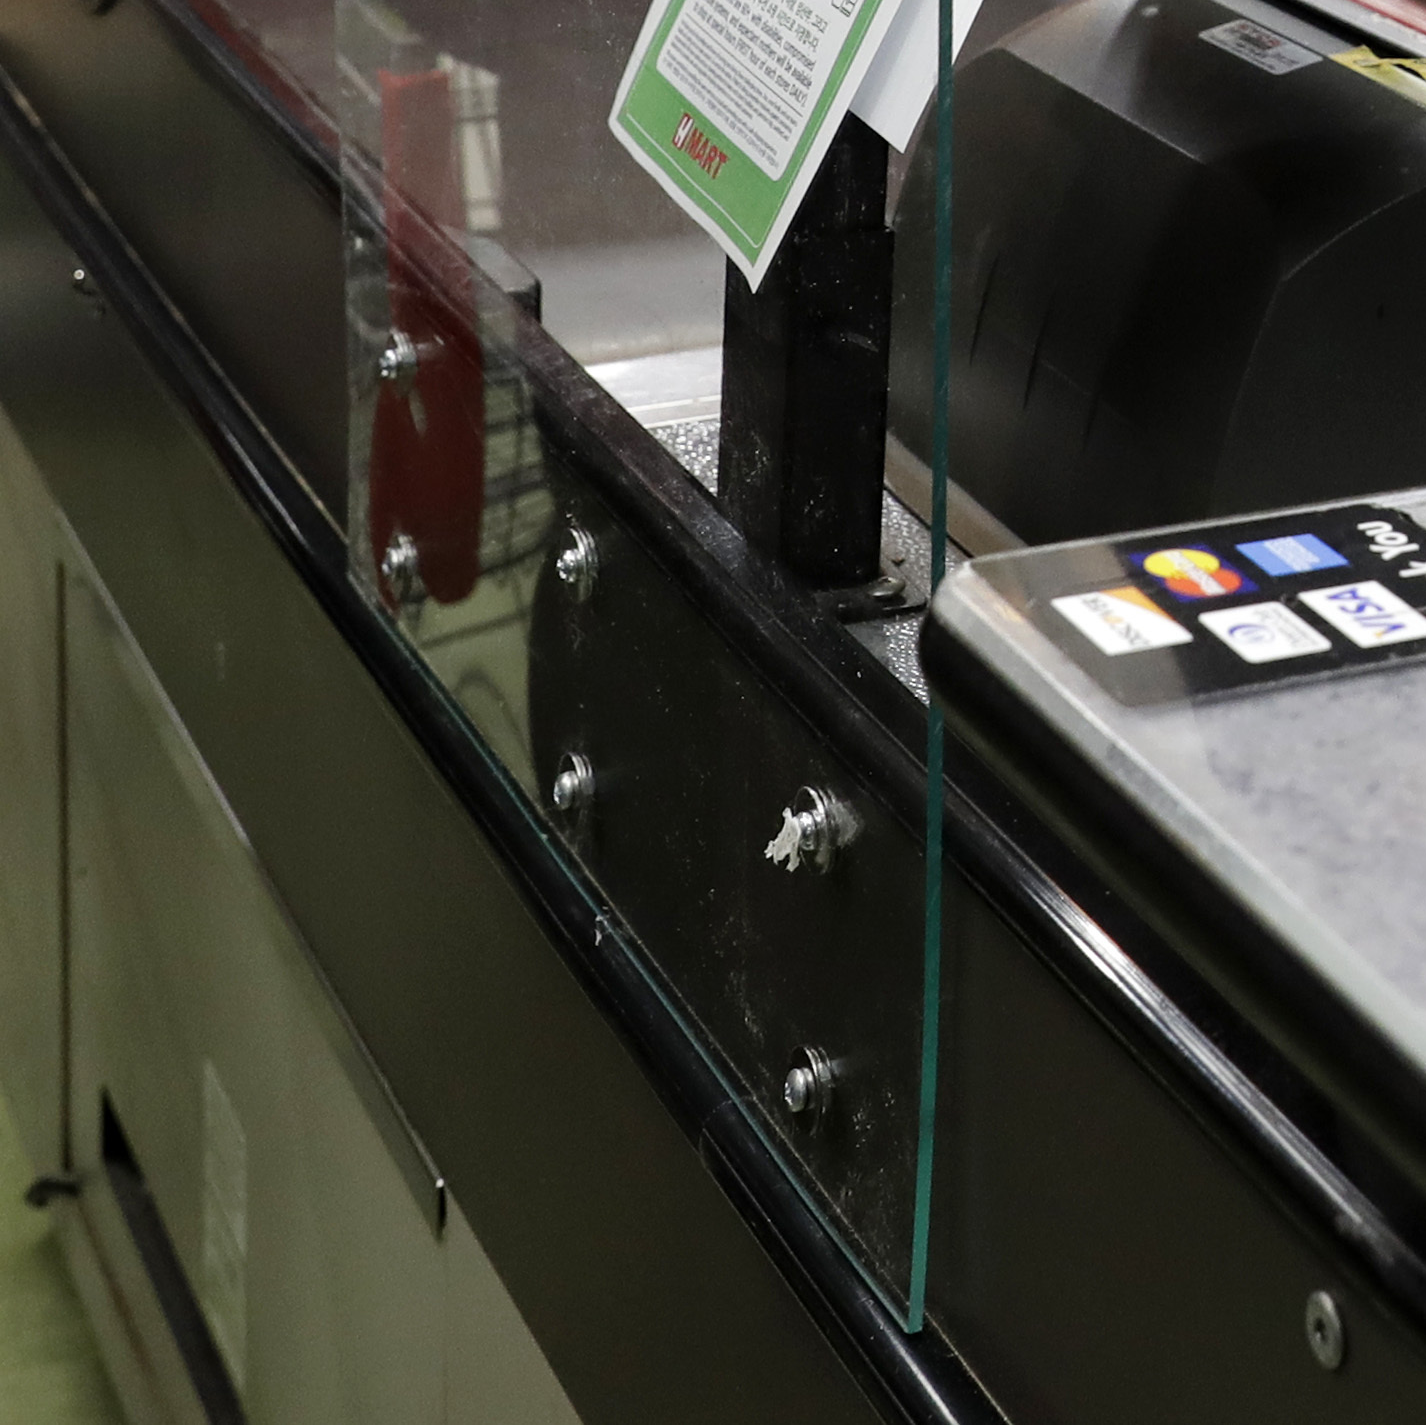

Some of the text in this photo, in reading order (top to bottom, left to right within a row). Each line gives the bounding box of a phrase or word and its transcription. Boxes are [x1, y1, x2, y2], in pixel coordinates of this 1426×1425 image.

[685, 127, 729, 180] MART
[1356, 520, 1419, 561] You
[1327, 586, 1405, 640] VISA
